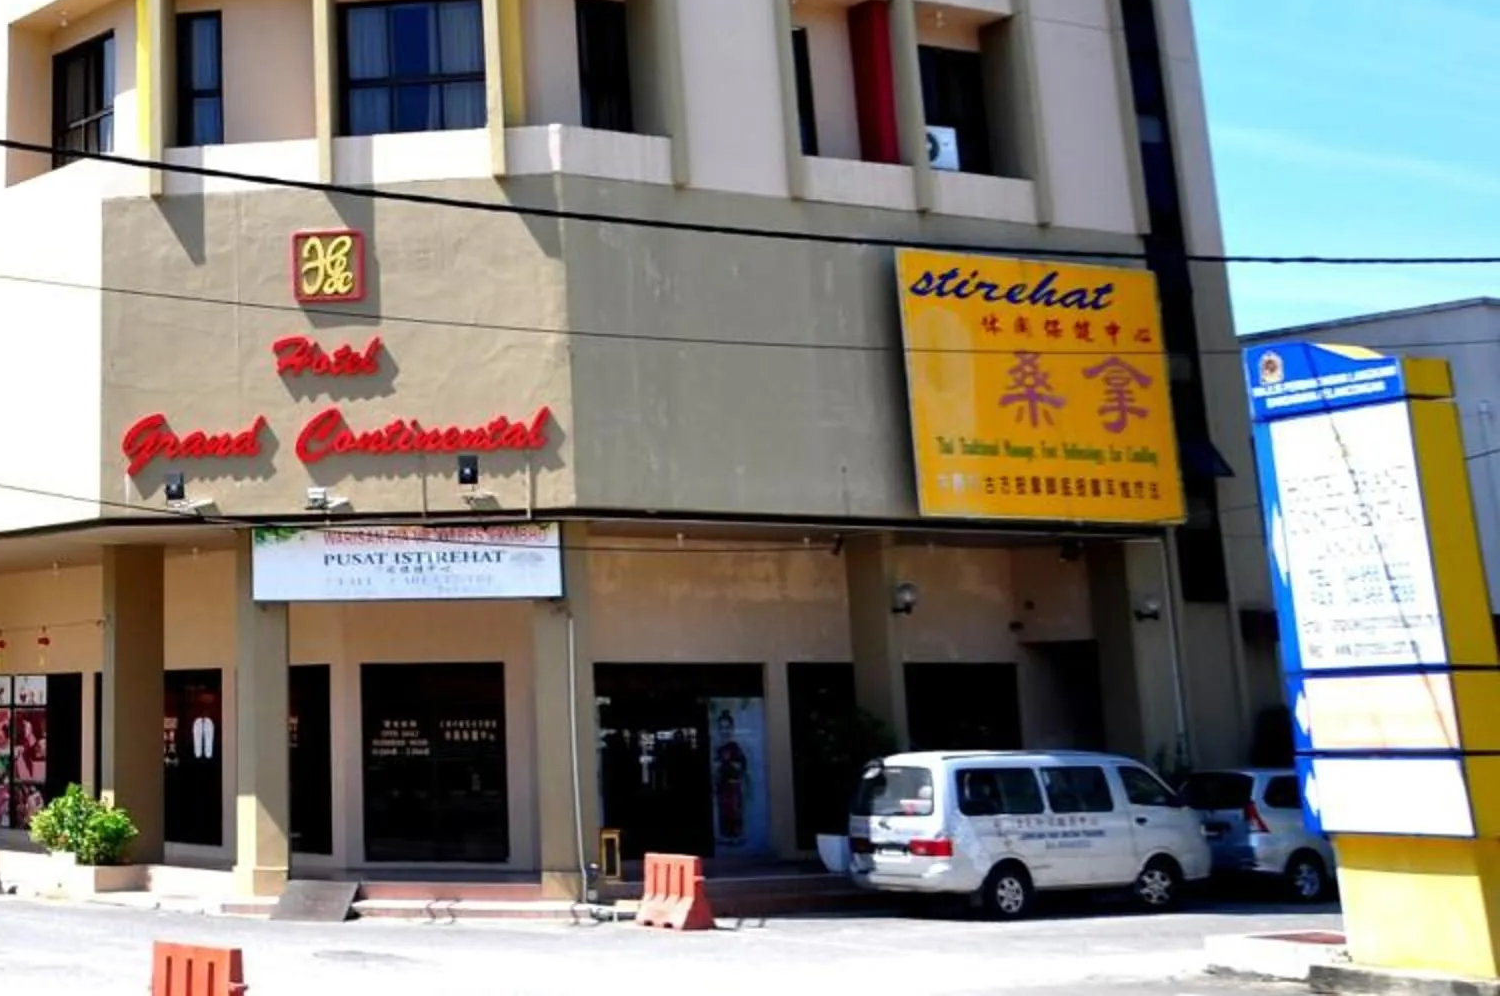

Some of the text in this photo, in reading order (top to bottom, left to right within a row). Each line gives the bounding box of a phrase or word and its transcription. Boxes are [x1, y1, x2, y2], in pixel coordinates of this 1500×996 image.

[272, 336, 383, 377] Hotel
[997, 349, 1154, 434] 桑拿
[121, 406, 552, 478] Grand Continental
[323, 549, 505, 567] PUSAT ISTIREHAT
